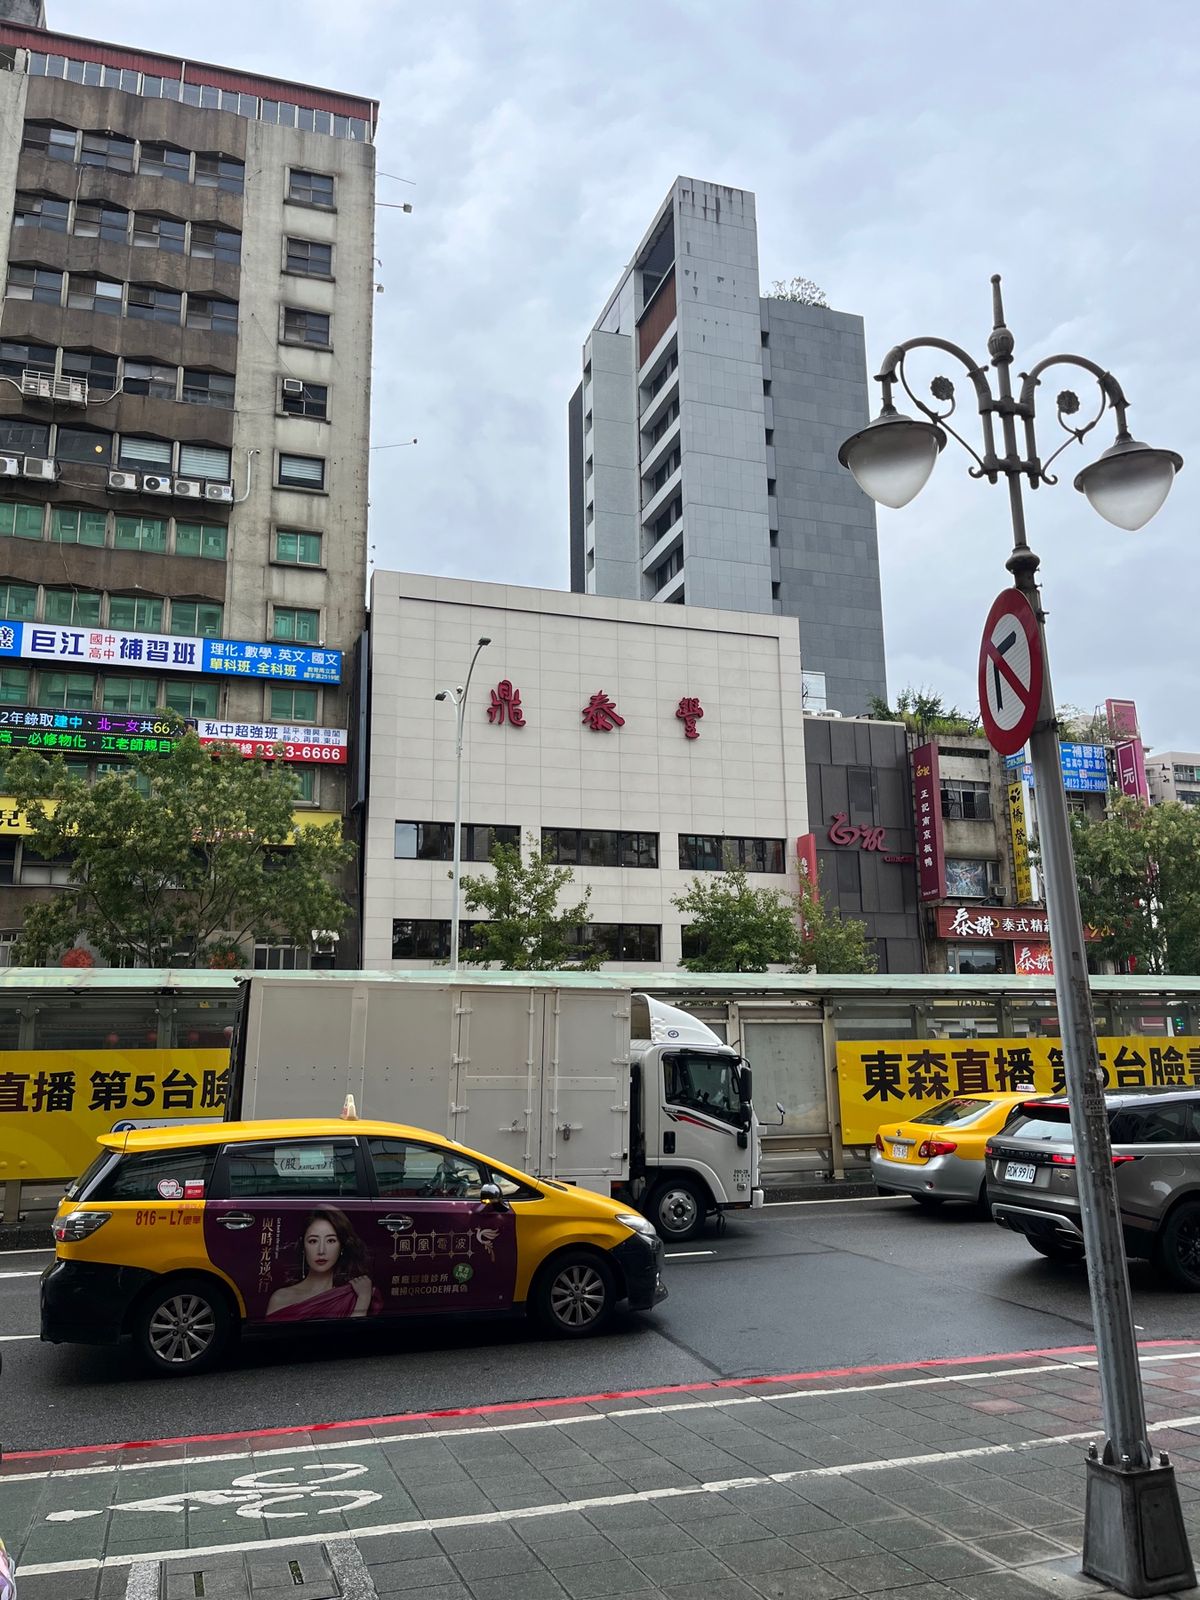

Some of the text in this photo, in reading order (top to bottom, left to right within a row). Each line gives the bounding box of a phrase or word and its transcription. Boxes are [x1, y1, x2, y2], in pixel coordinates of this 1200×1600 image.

[31, 629, 85, 656] 巨江
[90, 633, 116, 646] 國中
[119, 637, 196, 664] 補習班
[89, 647, 115, 660] 高中
[205, 722, 278, 740] 私中超強班
[861, 1047, 1036, 1102] 東森直播
